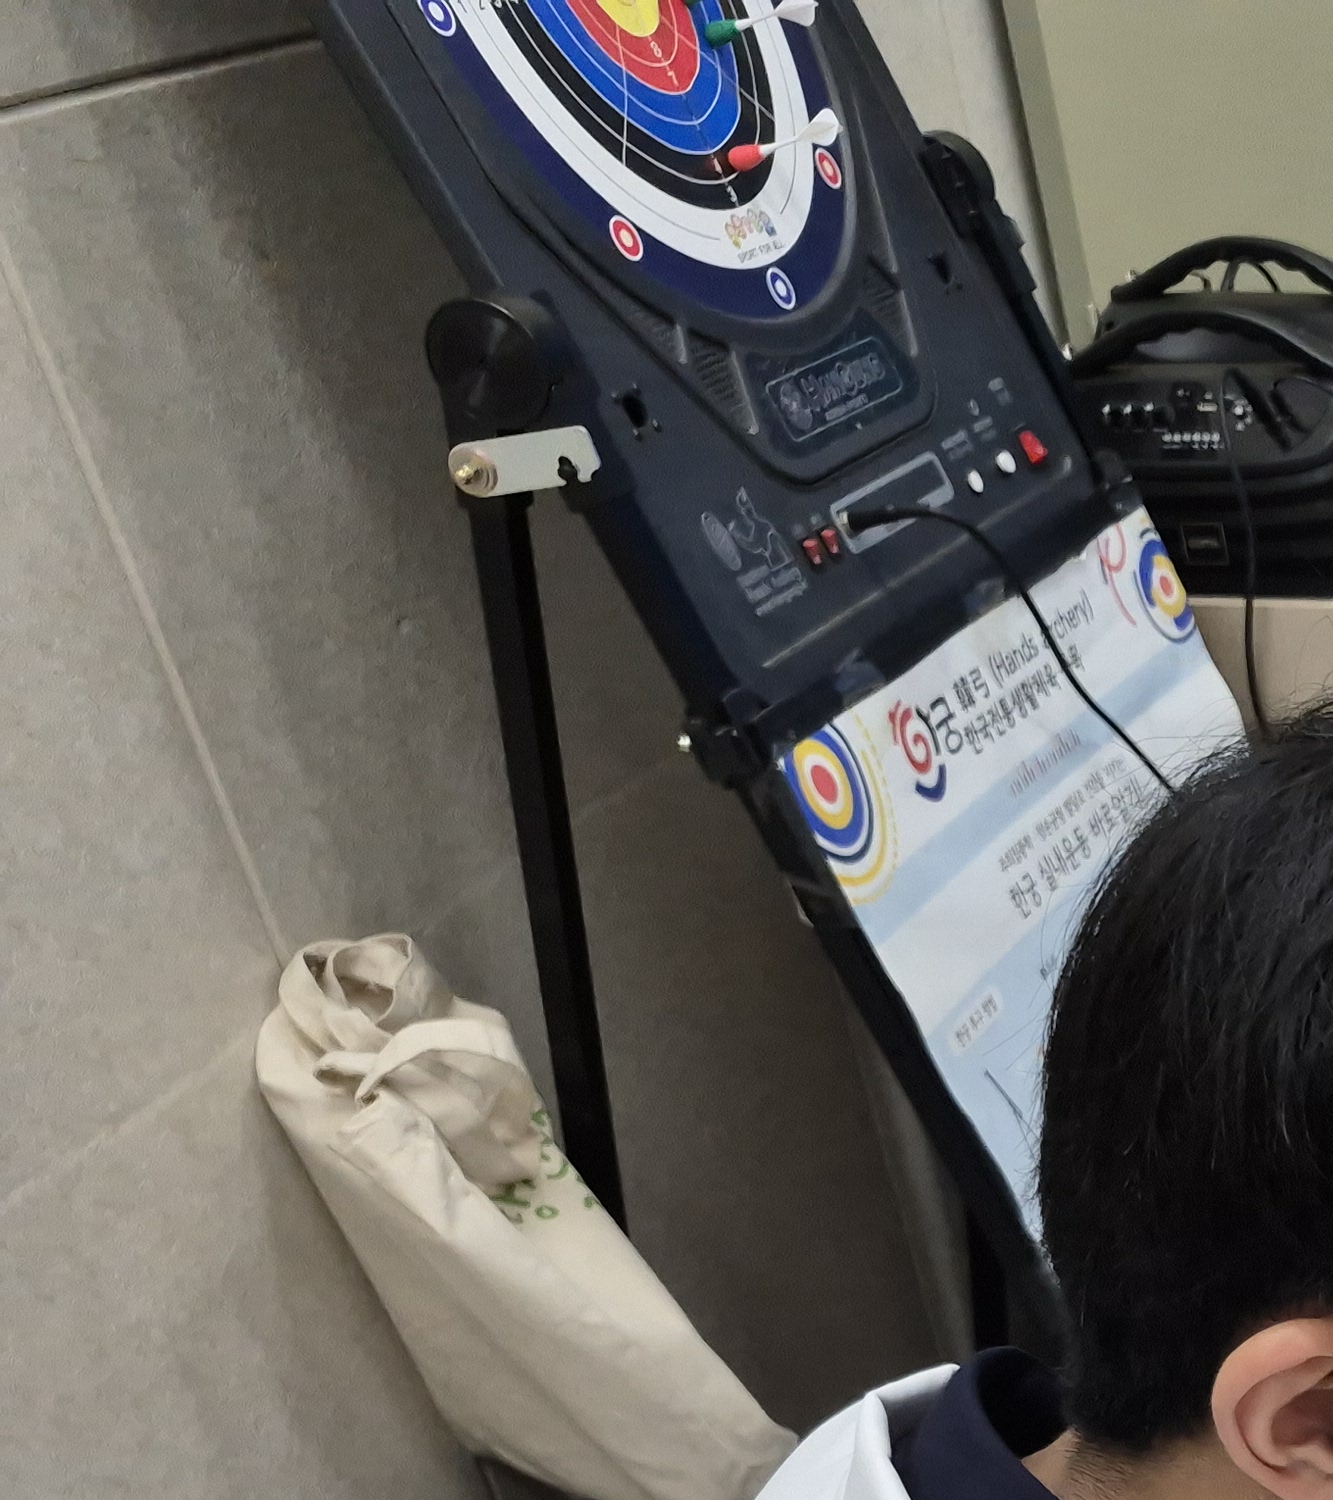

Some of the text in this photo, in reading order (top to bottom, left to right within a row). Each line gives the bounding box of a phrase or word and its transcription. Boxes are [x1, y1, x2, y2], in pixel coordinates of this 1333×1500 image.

[649, 41, 662, 58] 8
[988, 630, 1041, 689] (Hands
[1042, 587, 1095, 650] achery)
